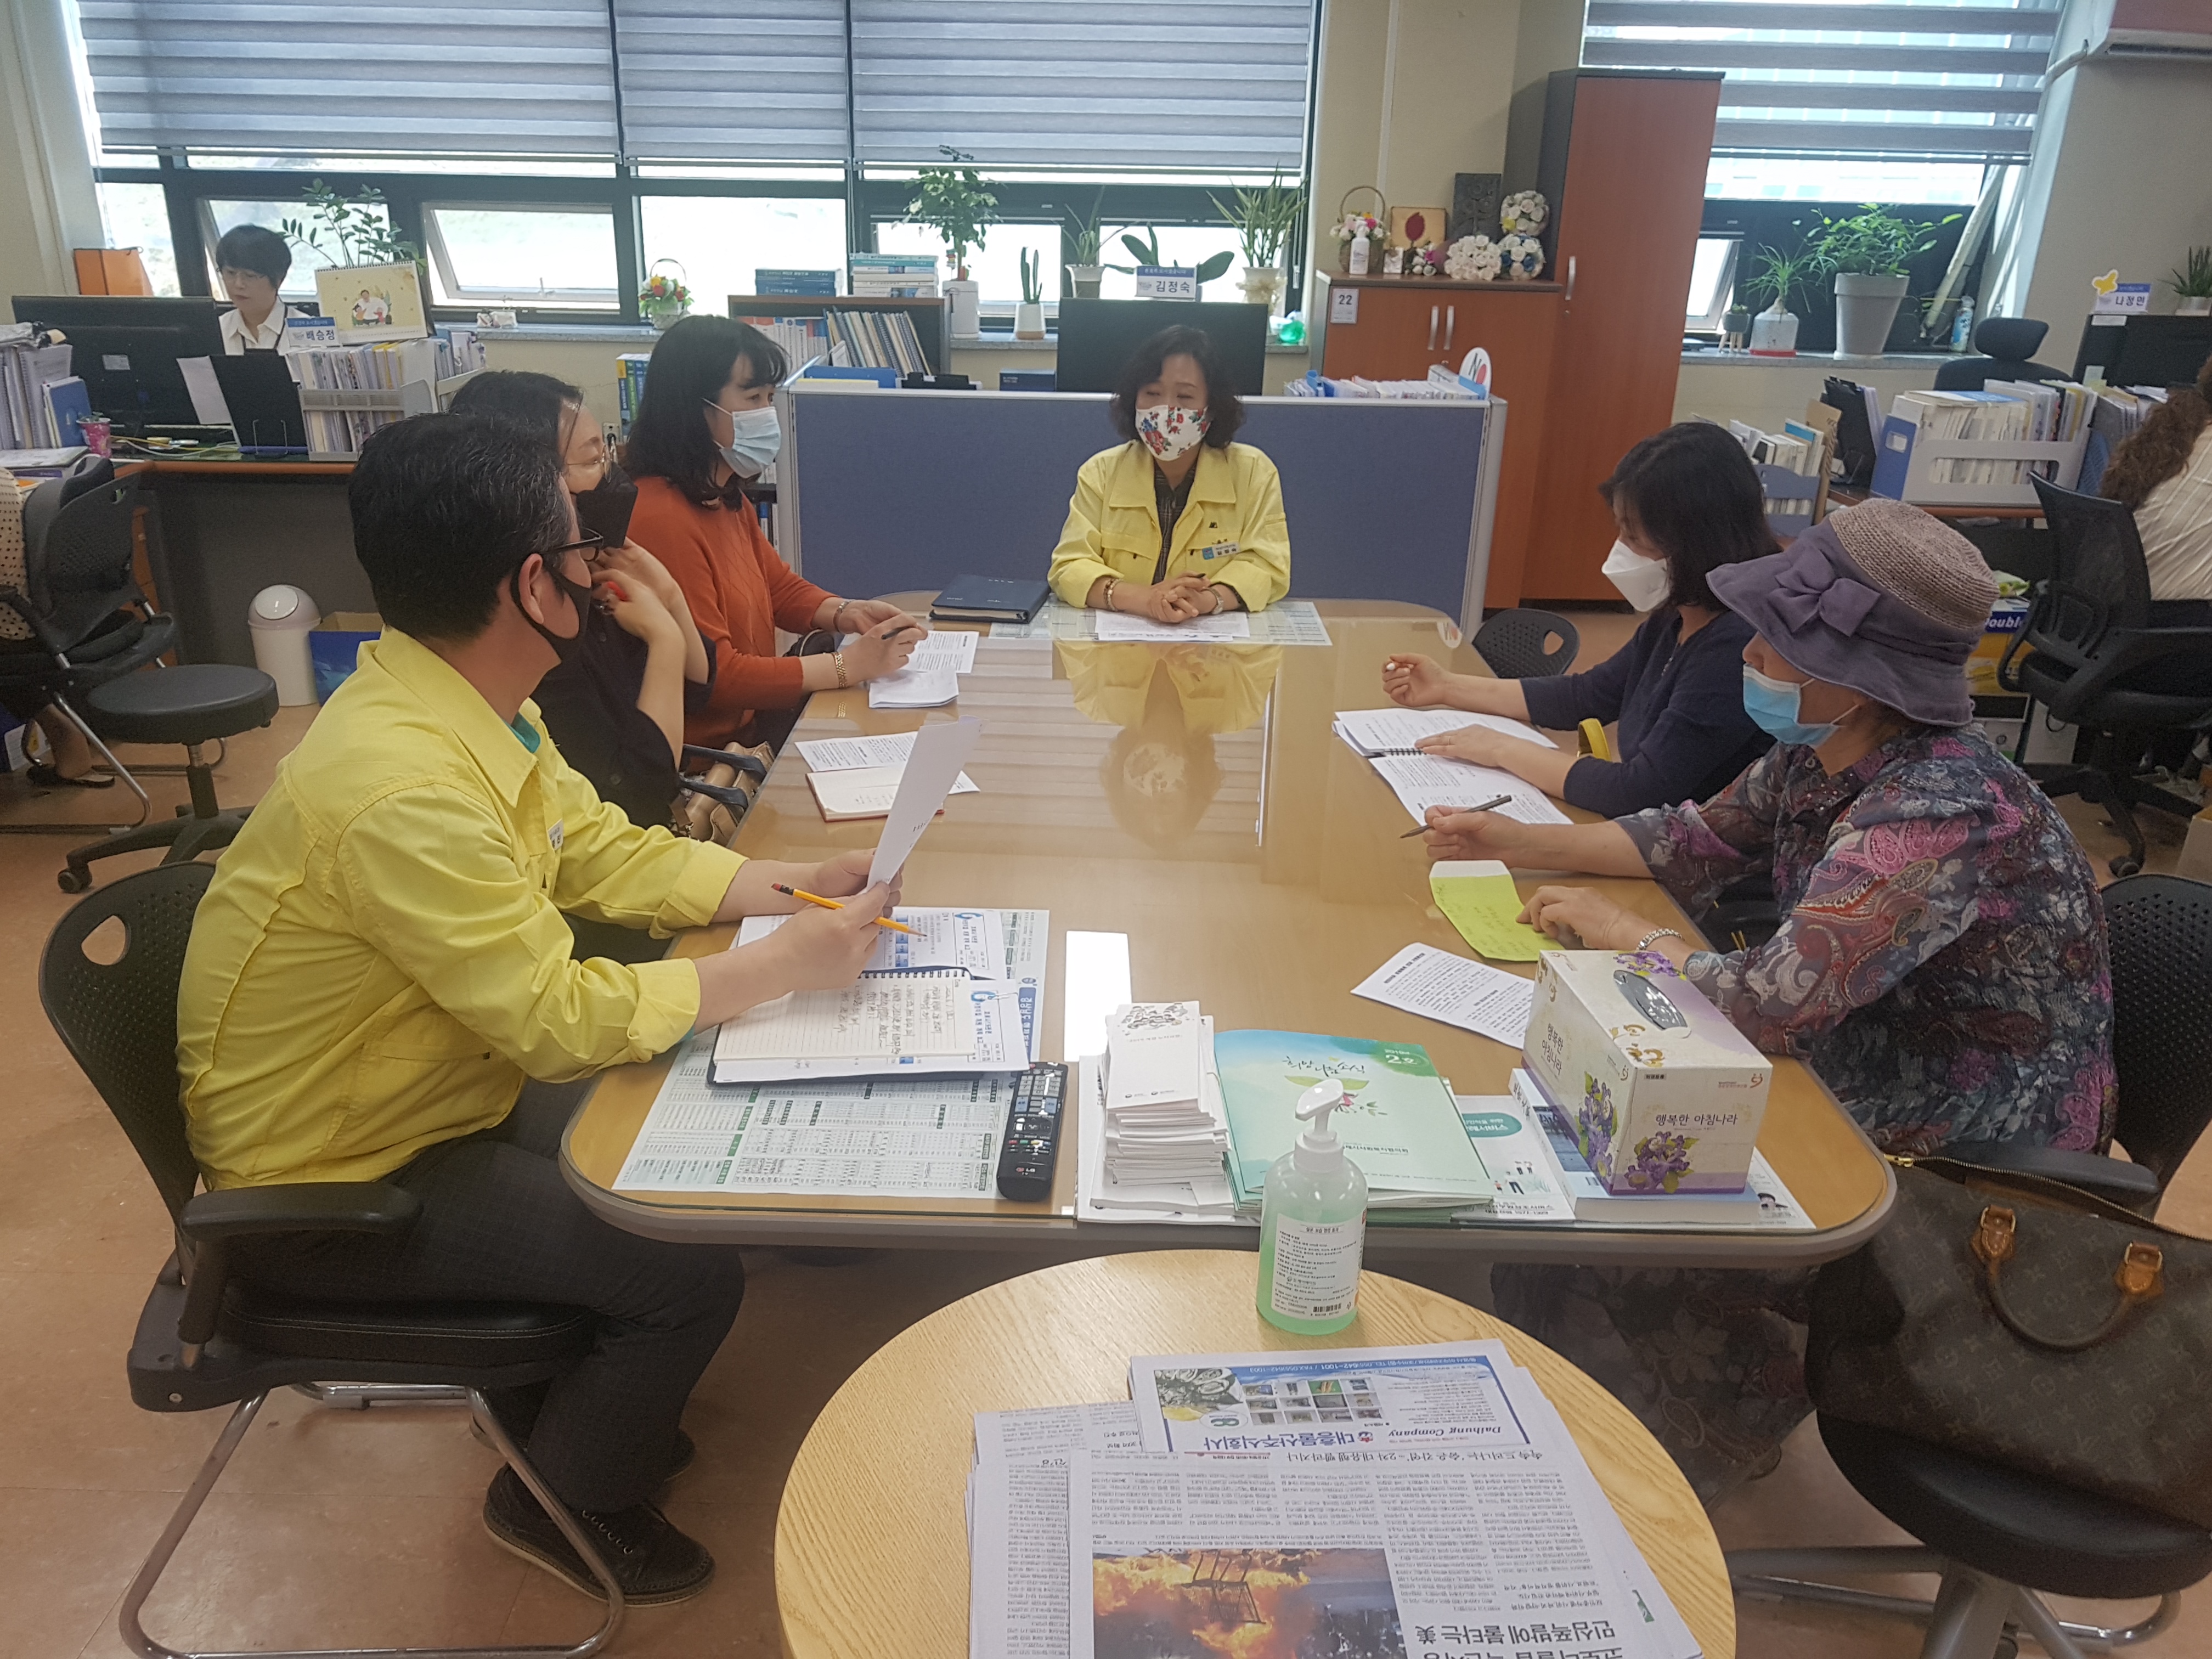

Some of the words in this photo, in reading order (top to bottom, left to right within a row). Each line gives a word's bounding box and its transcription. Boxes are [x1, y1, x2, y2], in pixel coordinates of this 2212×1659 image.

[1156, 280, 1190, 294] 김정숙
[1339, 295, 1352, 305] 22
[2115, 296, 2145, 306] 나정민
[306, 329, 335, 341] 배승정
[1547, 1023, 1564, 1055] 행복한
[1385, 1054, 1418, 1064] 2호
[1542, 1040, 1562, 1075] 아침나라
[1656, 1114, 1690, 1127] 행복한
[1694, 1114, 1738, 1126] 아침나라
[1389, 1428, 1444, 1437] Company
[1449, 1426, 1502, 1435] Daihung
[1203, 1431, 1355, 1451] 대흥물산주식회사
[1414, 1625, 1437, 1645] 美
[1441, 1624, 1505, 1645] 불타는
[1508, 1620, 1616, 1644] 민심폭발에
